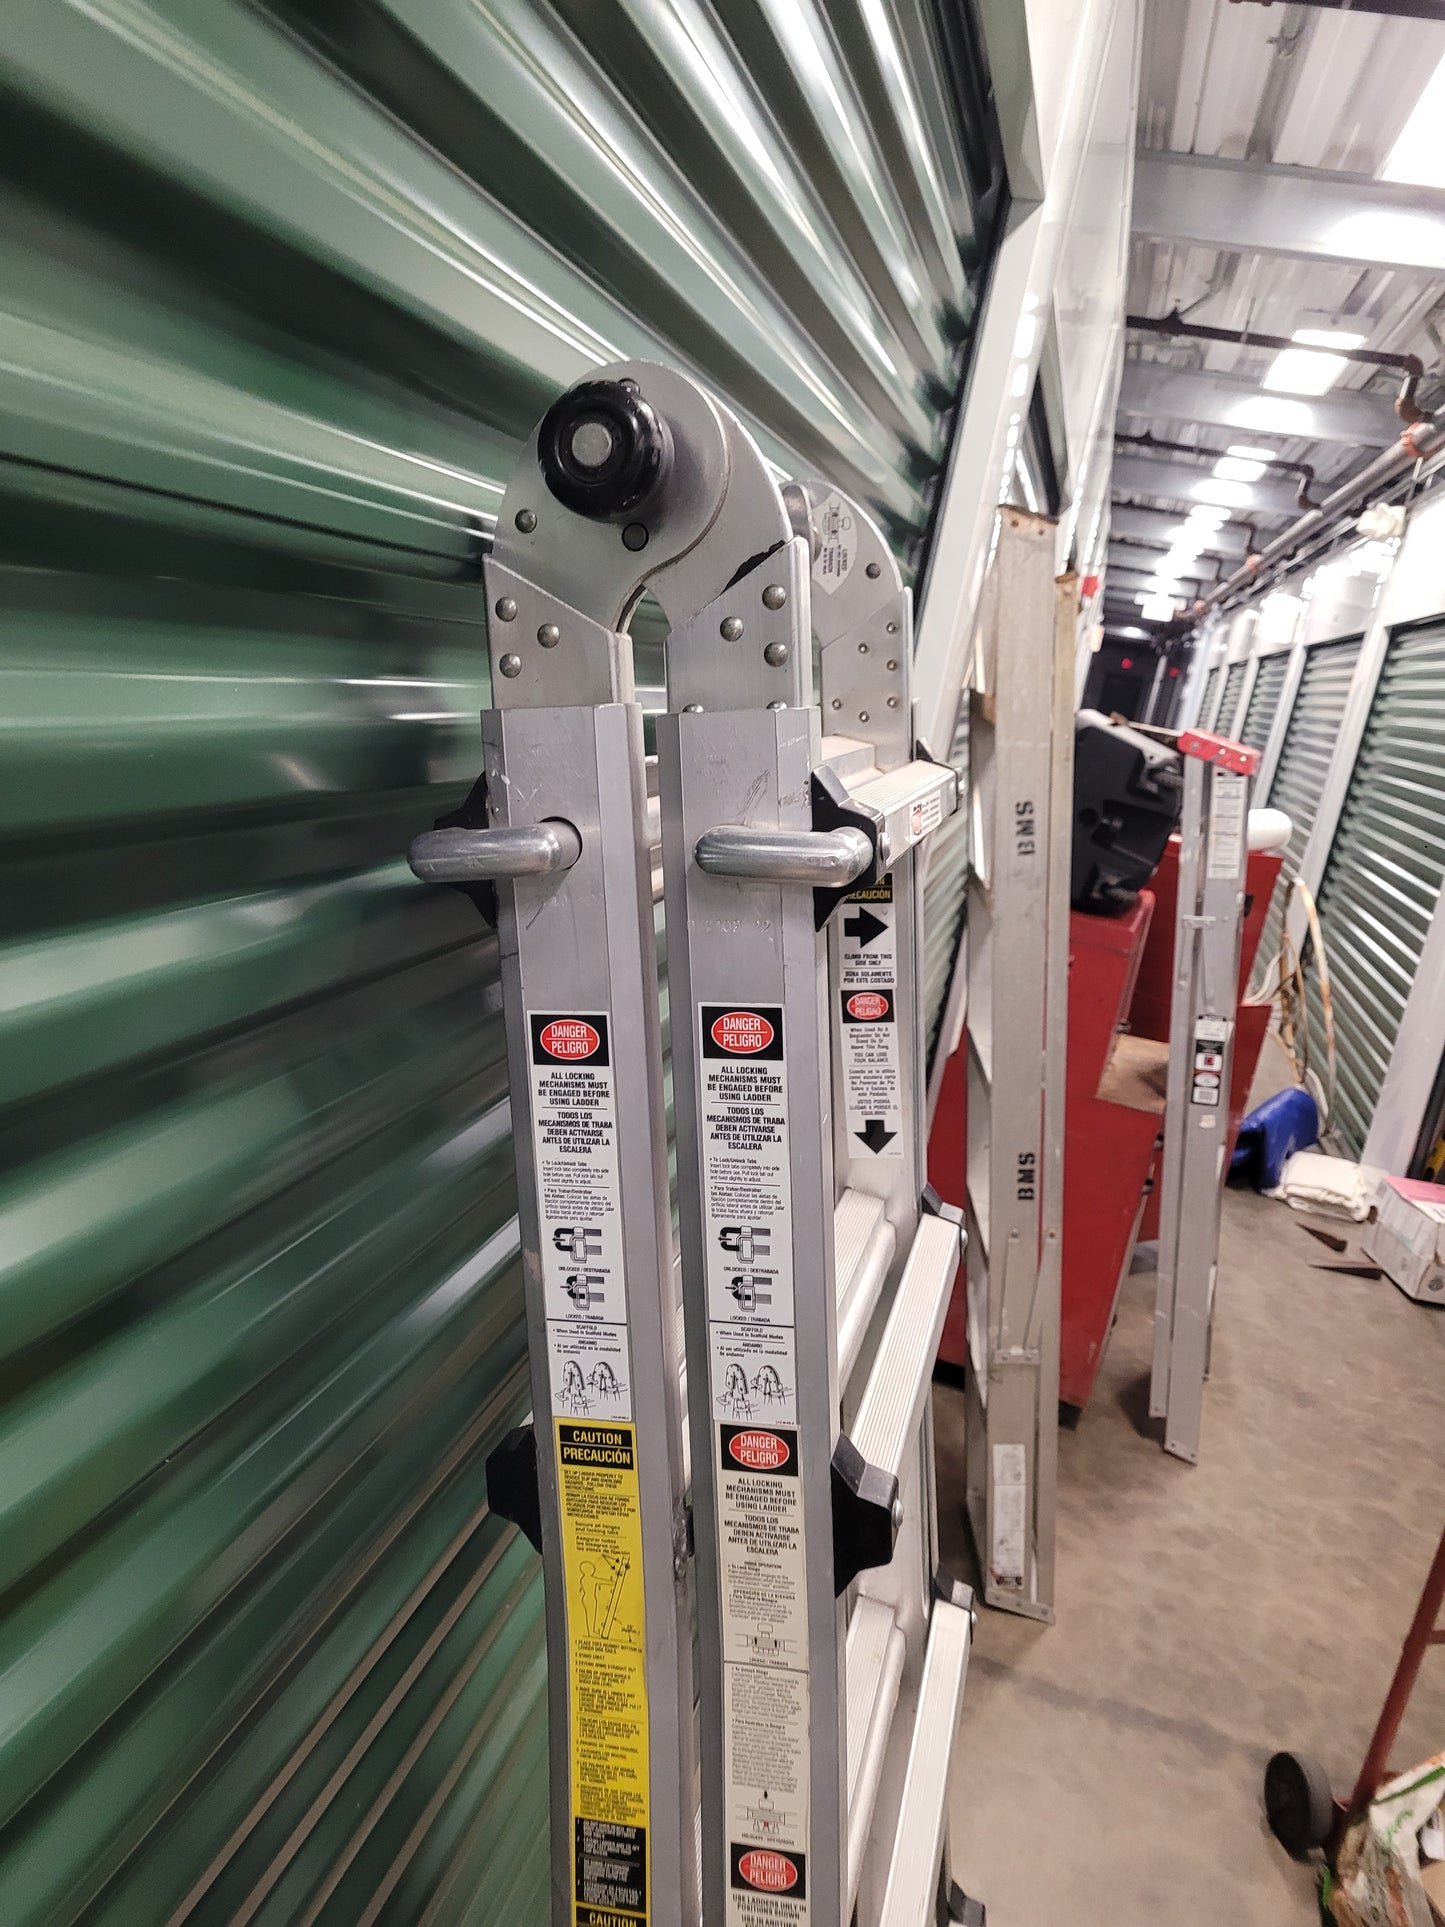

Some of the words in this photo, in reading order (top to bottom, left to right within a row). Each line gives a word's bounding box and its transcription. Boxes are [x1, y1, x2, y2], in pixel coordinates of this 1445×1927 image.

[1015, 800, 1036, 856] BMS
[854, 1007, 882, 1015] PELIGRO
[722, 1017, 761, 1031] DANGER
[551, 1025, 588, 1038] DANGER
[723, 1033, 762, 1049] PELIGRO
[551, 1040, 589, 1054] PELIGRO
[721, 1066, 732, 1074] ALL
[736, 1067, 767, 1075] LOCKING
[550, 1072, 562, 1080] ALL
[564, 1072, 595, 1080] LOCKING
[708, 1075, 757, 1084] MECHANISMS
[759, 1076, 780, 1084] MUST
[539, 1080, 585, 1089] MECHANISMS
[707, 1084, 716, 1092] BE
[718, 1084, 752, 1093] ENGAGED
[754, 1085, 783, 1094] BEFORE
[538, 1089, 546, 1097] BE
[549, 1090, 580, 1098] ENGAGED
[582, 1090, 610, 1098] BEFORE
[742, 1094, 771, 1102] LADDER
[549, 1098, 570, 1106] USING
[571, 1098, 599, 1106] LADDER
[579, 1112, 592, 1120] LOS
[727, 1107, 750, 1115] TODOS
[750, 1107, 764, 1115] LOS
[538, 1120, 580, 1128] MECANISMOS
[591, 1121, 612, 1129] TRABA
[706, 1116, 751, 1125] MECANISMOS
[752, 1117, 761, 1125] DE
[763, 1117, 785, 1125] TRABA
[568, 1129, 603, 1137] ACTIVARSE
[715, 1125, 737, 1133] DEBEN
[738, 1125, 775, 1134] ACTIVARSE
[542, 1137, 562, 1145] ANTES
[562, 1137, 571, 1145] DE
[572, 1138, 600, 1146] UTILIZAR
[710, 1133, 731, 1142] ANTES
[732, 1133, 740, 1142] DE
[742, 1134, 772, 1143] UTILIZAR
[772, 1135, 782, 1143] LA
[559, 1146, 592, 1154] ESCALERA
[728, 1143, 762, 1151] ESCALERA
[1017, 1152, 1036, 1201] BMS
[573, 1430, 623, 1445] CAUTION
[740, 1434, 778, 1450] DANGER
[563, 1447, 631, 1464] PRECAUCIÓN
[740, 1450, 779, 1465] PELIGRO
[752, 1479, 782, 1488] LOCKING
[726, 1485, 773, 1496] MECHANISMS
[775, 1489, 795, 1497] MUST
[735, 1493, 768, 1503] ENGAGED
[769, 1496, 796, 1506] BEFORE
[735, 1501, 757, 1510] USING
[758, 1504, 786, 1512] LADDER
[744, 1515, 765, 1523] TODOS
[766, 1516, 778, 1524] LOS
[724, 1520, 767, 1531] MECANISMOS
[768, 1524, 776, 1532] DE
[779, 1525, 799, 1534] TRABA
[733, 1529, 754, 1538] DEBEN
[755, 1531, 790, 1540] ACTIVARSE
[727, 1536, 748, 1545] ANTES
[749, 1538, 758, 1546] DE
[758, 1539, 787, 1549] UTILIZAR
[788, 1542, 796, 1550] LA
[746, 1546, 778, 1556] ESCALERA
[750, 1854, 787, 1872] DANGER
[749, 1869, 788, 1888] PELIGRO
